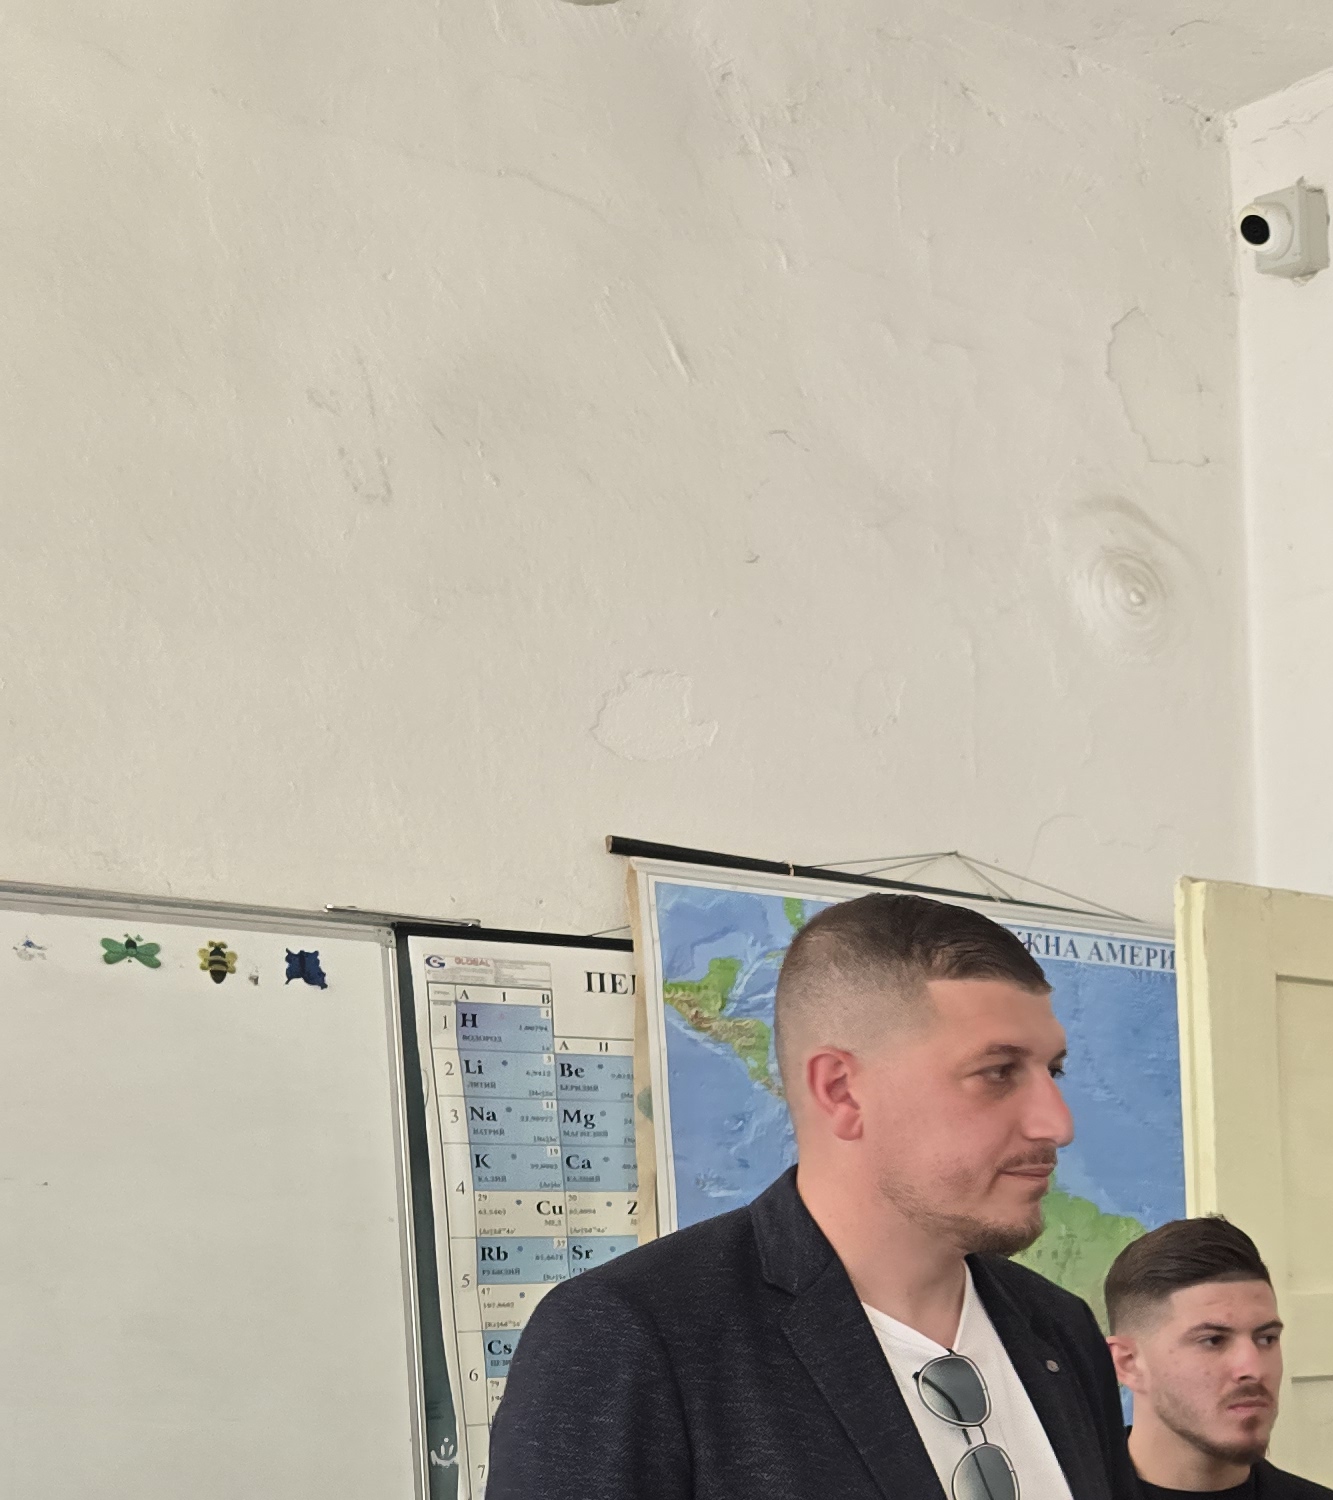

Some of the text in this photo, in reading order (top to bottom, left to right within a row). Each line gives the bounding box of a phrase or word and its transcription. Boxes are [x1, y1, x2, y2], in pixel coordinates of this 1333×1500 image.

[1018, 931, 1175, 970] ЖНА АМЕРИ
[460, 1013, 478, 1029] H
[463, 1059, 483, 1075] Li
[559, 1062, 585, 1078] Be
[469, 1106, 497, 1122] Na
[562, 1109, 596, 1129] Mg
[475, 1153, 491, 1169] K
[565, 1153, 592, 1170] Ca
[536, 1201, 564, 1216] Cu
[481, 1245, 509, 1262] Rb
[571, 1244, 594, 1261] Sr
[487, 1339, 513, 1356] Cs
